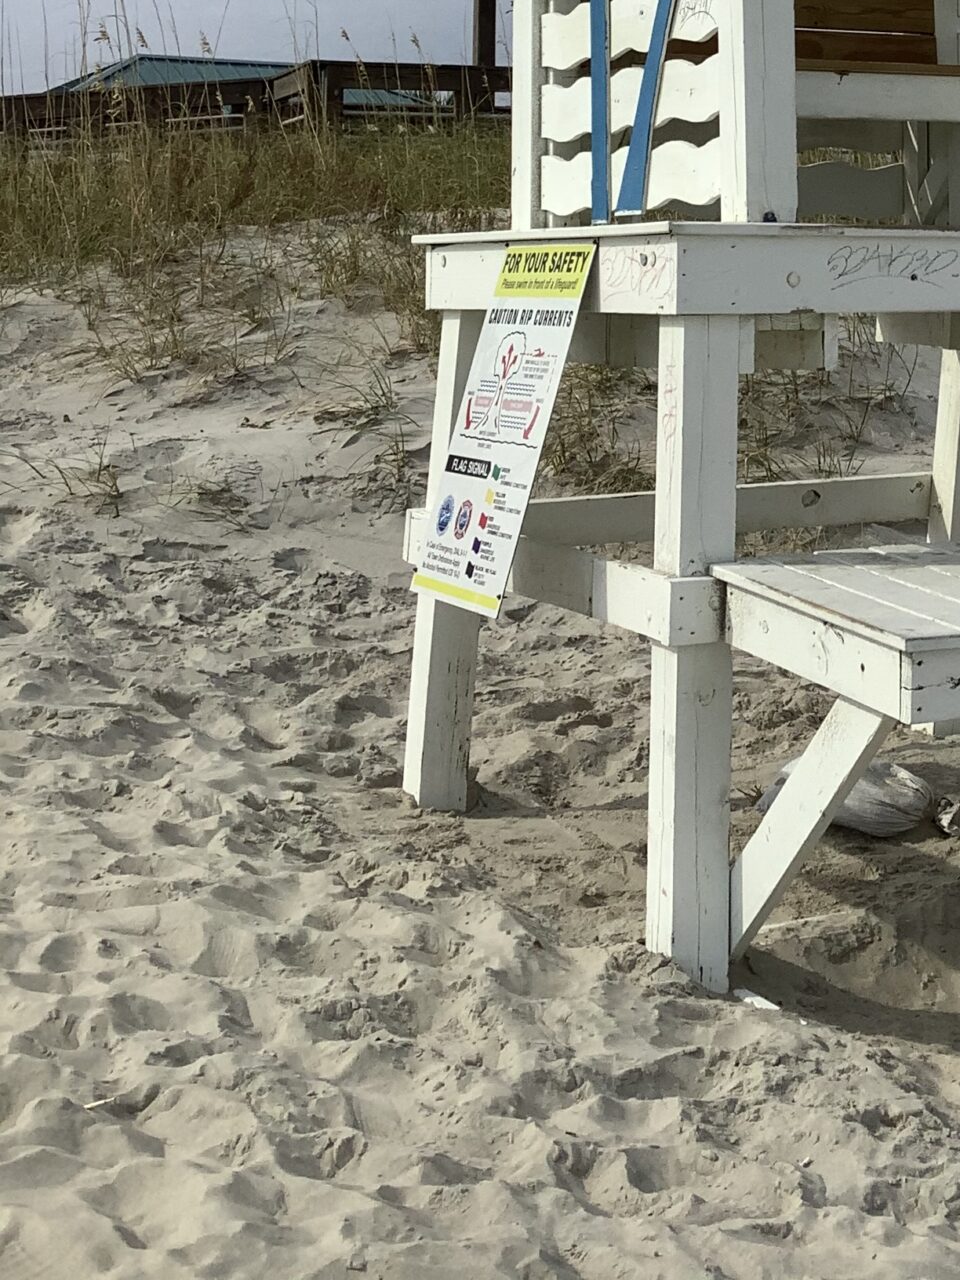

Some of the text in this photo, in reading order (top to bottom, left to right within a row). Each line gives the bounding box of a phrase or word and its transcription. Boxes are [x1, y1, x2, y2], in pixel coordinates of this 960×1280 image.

[502, 251, 590, 273] FOR YOUR SAFETY
[502, 279, 516, 289] Please
[516, 280, 528, 289] swim
[532, 279, 546, 289] front
[544, 278, 553, 289] of
[488, 308, 574, 327] CAUTION RIP CURRENTS
[451, 458, 488, 476] FLAG SIGNAL
